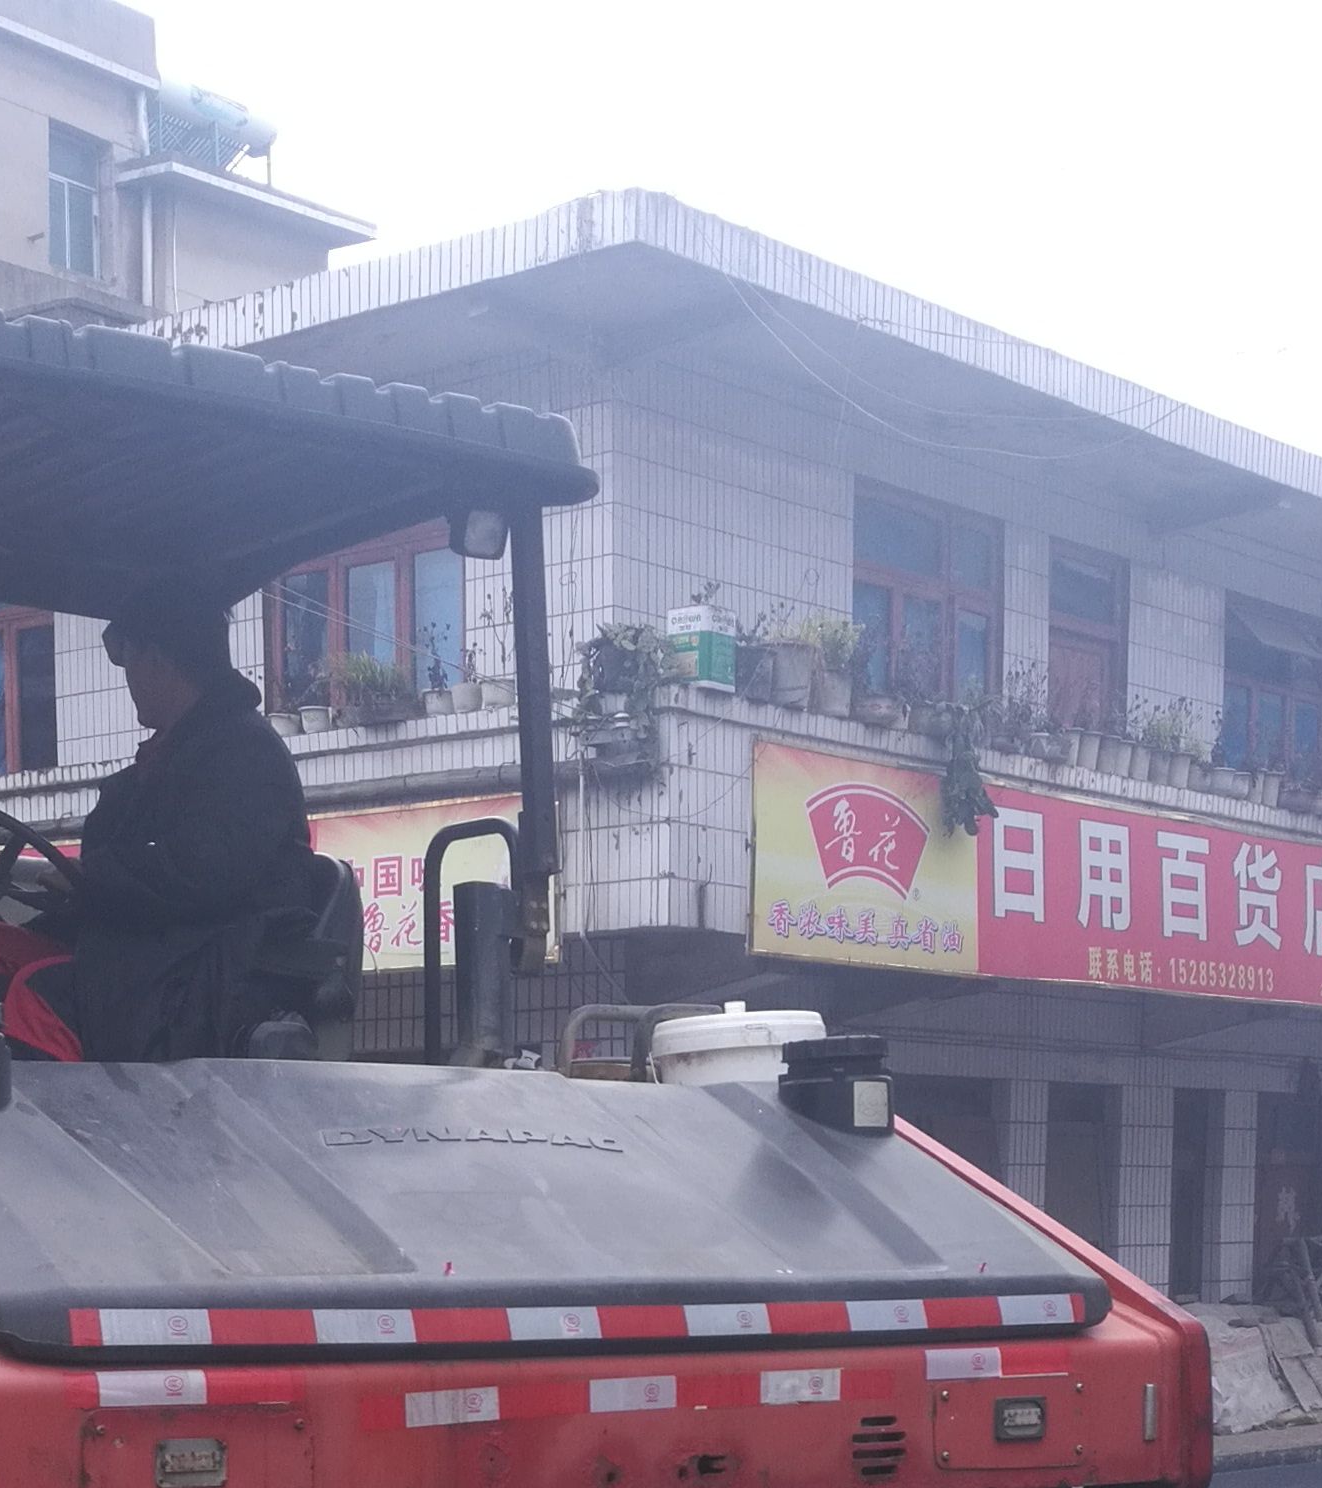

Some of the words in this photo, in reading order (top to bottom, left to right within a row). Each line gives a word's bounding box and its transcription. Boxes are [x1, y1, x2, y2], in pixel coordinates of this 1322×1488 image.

[767, 899, 878, 945] 香浓味美
[888, 917, 964, 953] 真省油
